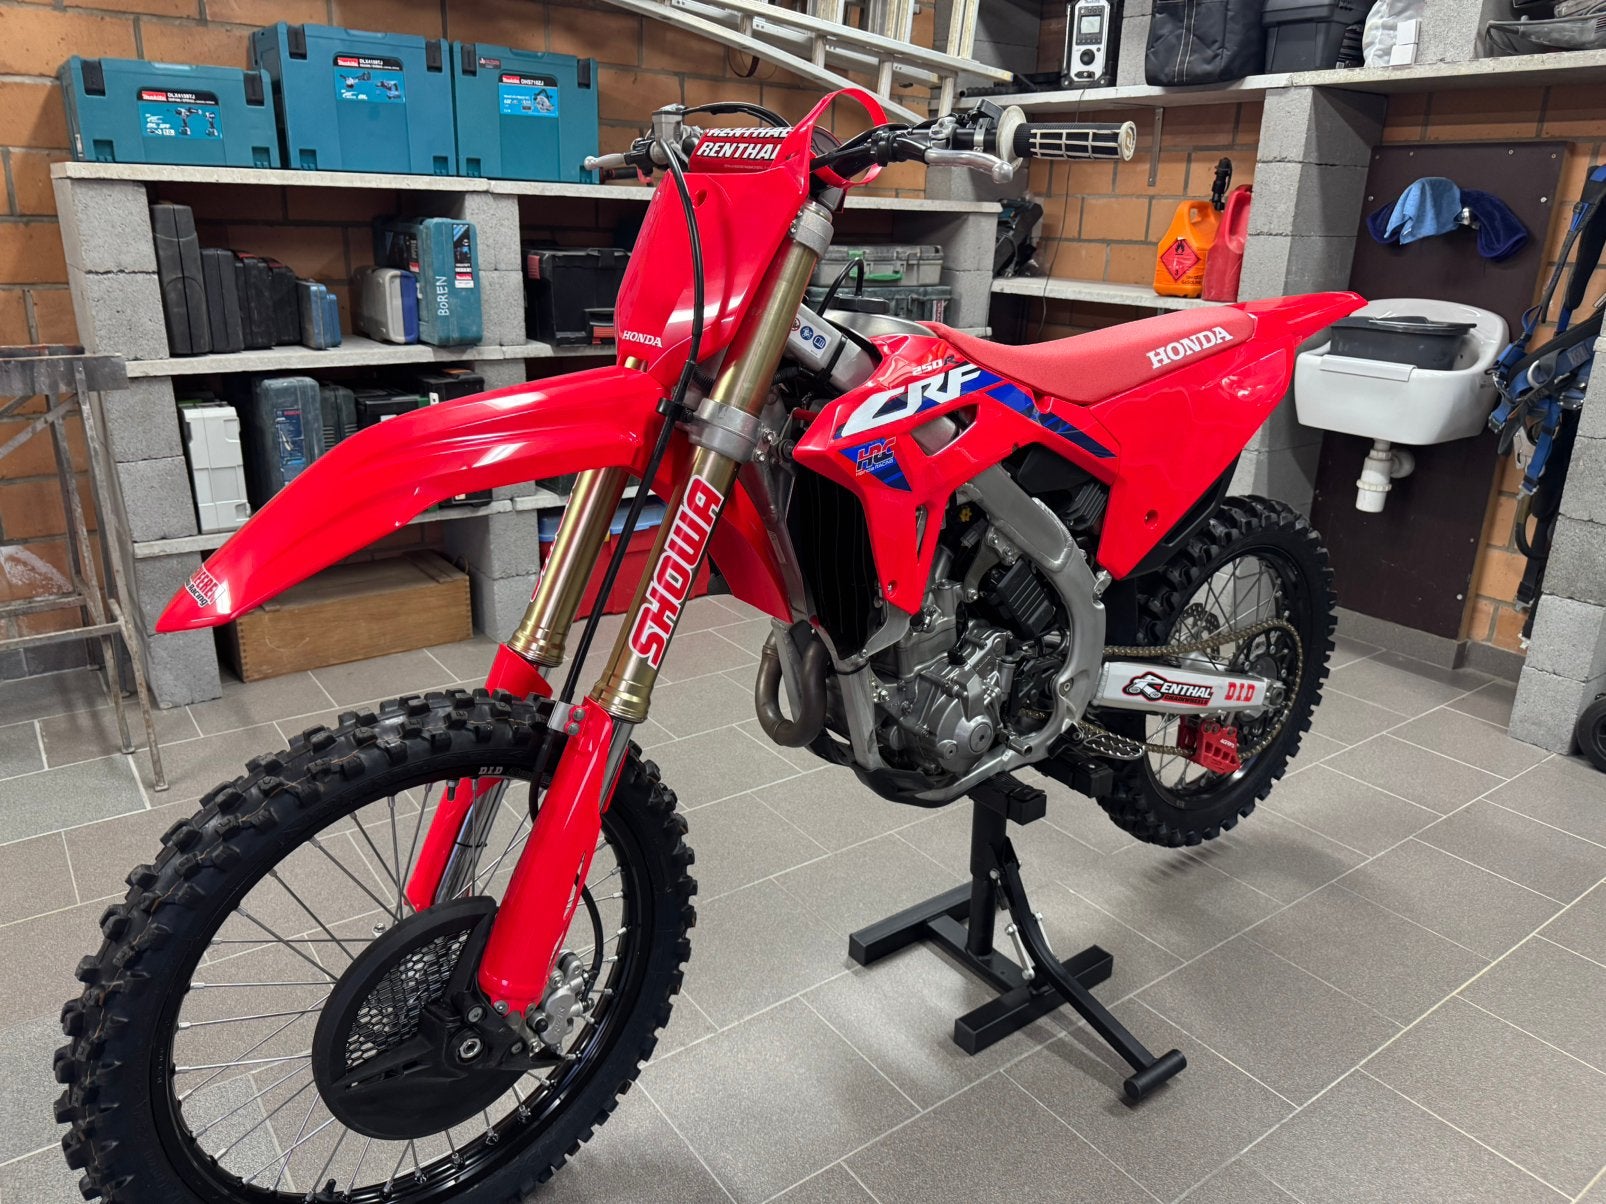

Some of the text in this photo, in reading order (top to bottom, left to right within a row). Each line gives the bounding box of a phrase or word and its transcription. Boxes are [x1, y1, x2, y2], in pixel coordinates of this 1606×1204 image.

[621, 330, 663, 348] HONDA
[1145, 326, 1234, 370] HONDA
[911, 355, 957, 377] 250R
[841, 363, 982, 438] CRF
[855, 436, 897, 474] HRC
[629, 475, 724, 670] SHOWA
